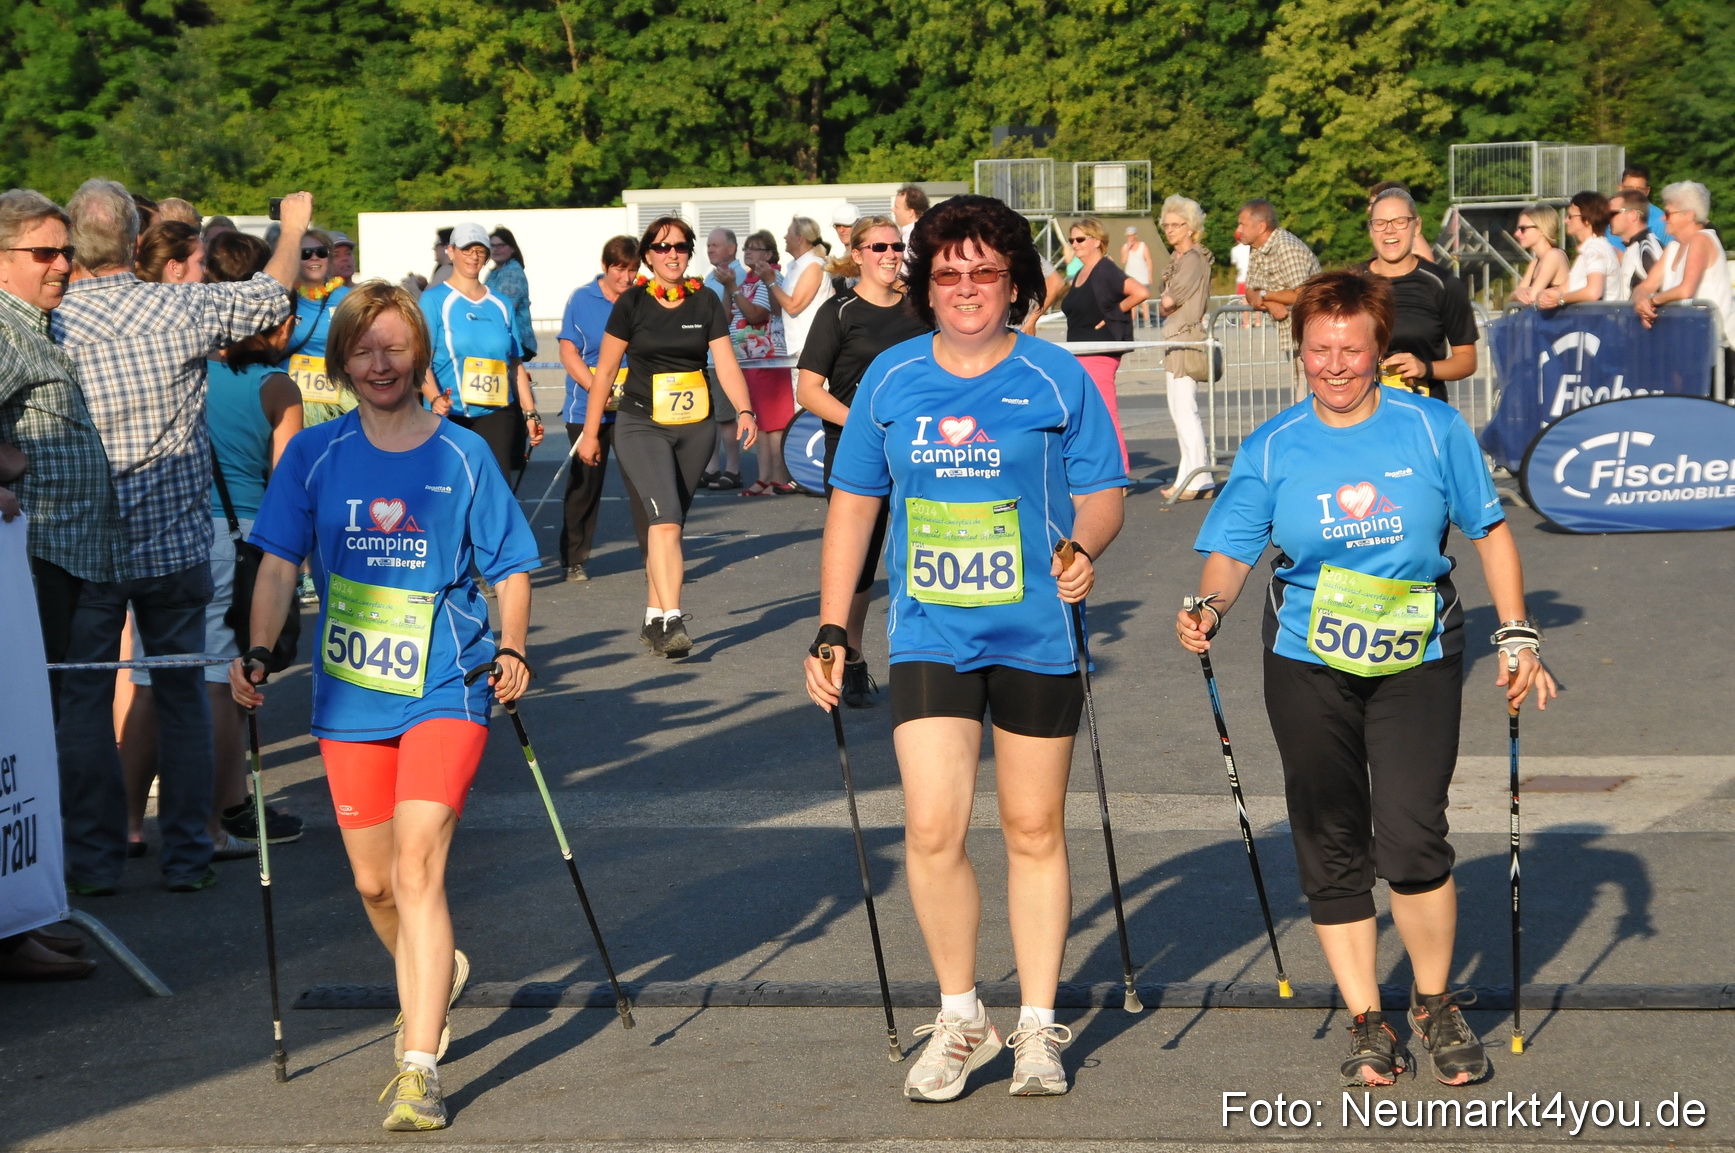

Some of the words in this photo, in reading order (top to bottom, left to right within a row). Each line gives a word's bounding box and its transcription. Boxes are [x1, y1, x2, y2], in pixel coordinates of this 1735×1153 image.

[469, 374, 500, 394] 481
[669, 391, 695, 411] 73
[911, 416, 933, 446] I
[911, 444, 1001, 467] camping
[968, 467, 1001, 479] Berger
[345, 499, 363, 532] I
[912, 503, 938, 516] 2014
[1316, 493, 1336, 525] I
[1322, 515, 1403, 540] camping
[346, 533, 428, 557] camping
[1374, 534, 1404, 545] Berger
[395, 558, 426, 569] Berger
[913, 549, 1016, 591] 5048
[331, 580, 354, 596] 2014
[1325, 571, 1357, 586] 2014
[1314, 616, 1424, 663] 5055
[327, 624, 420, 680] 5049
[0, 754, 17, 797] er
